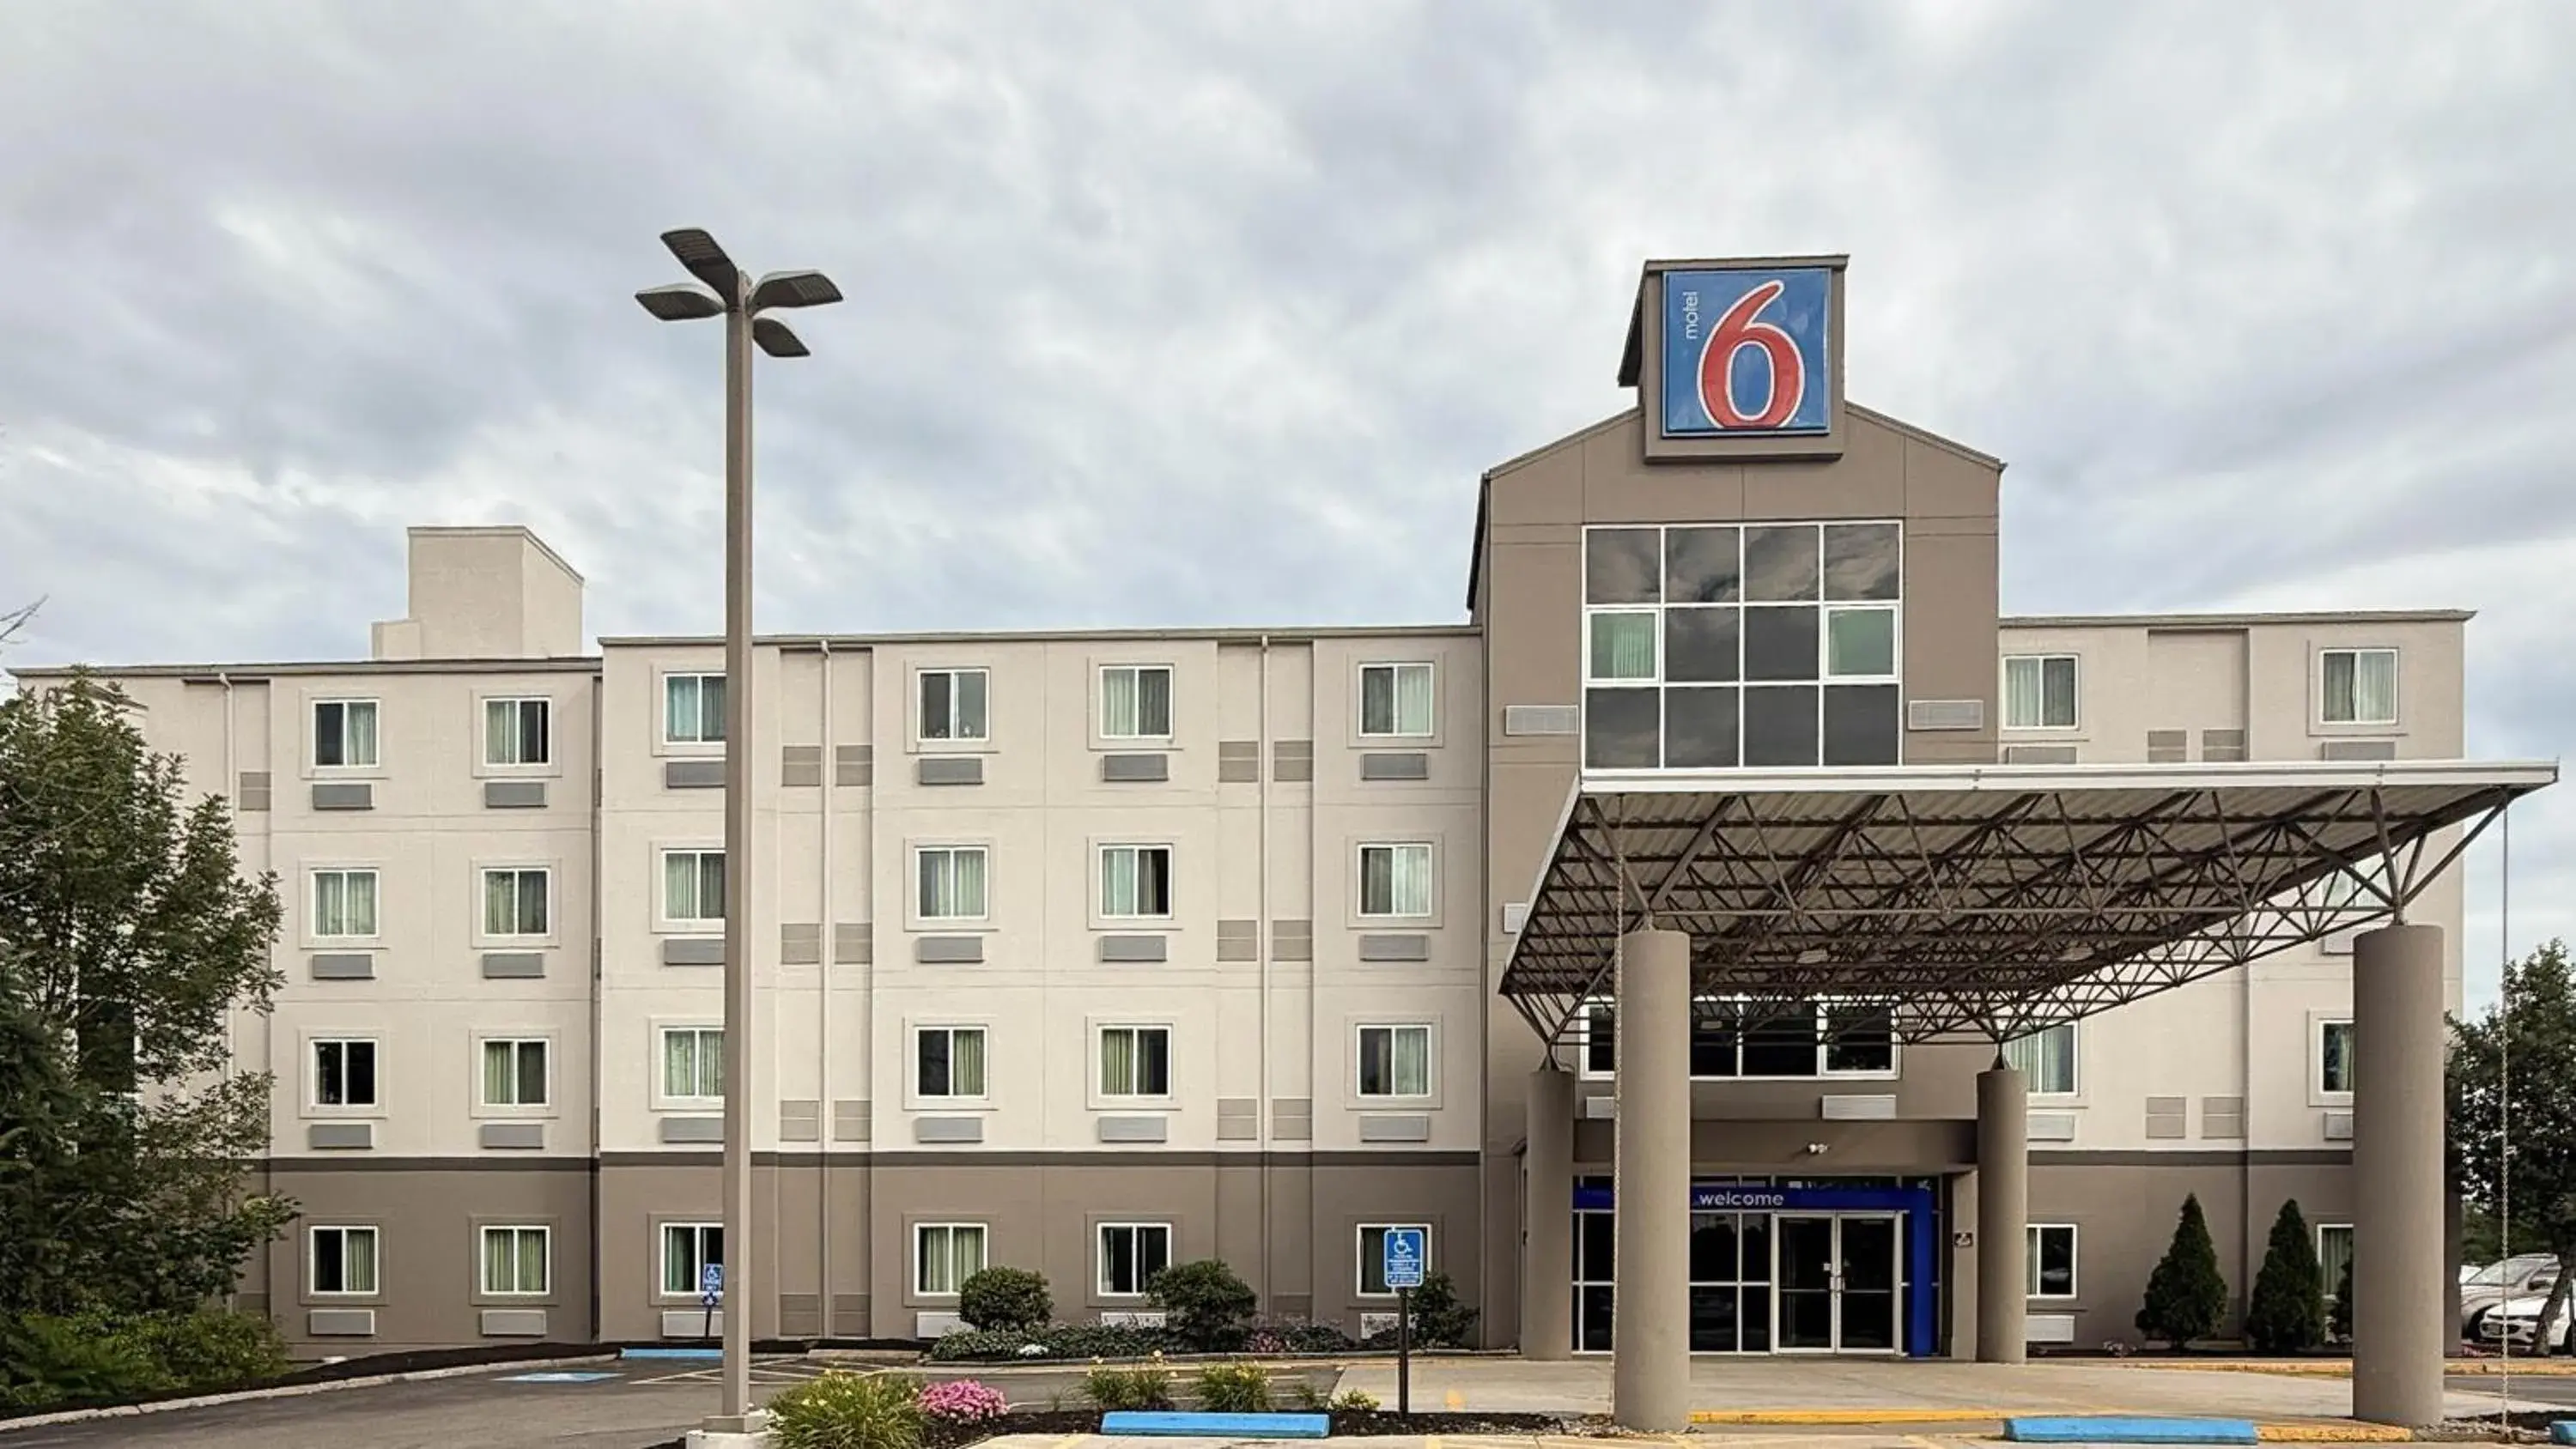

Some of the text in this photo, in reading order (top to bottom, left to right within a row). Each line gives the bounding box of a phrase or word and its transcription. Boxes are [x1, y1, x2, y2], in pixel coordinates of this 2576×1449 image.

[1682, 291, 1698, 340] motel
[1697, 280, 1805, 429] 6
[1698, 1191, 1784, 1206] welcome
